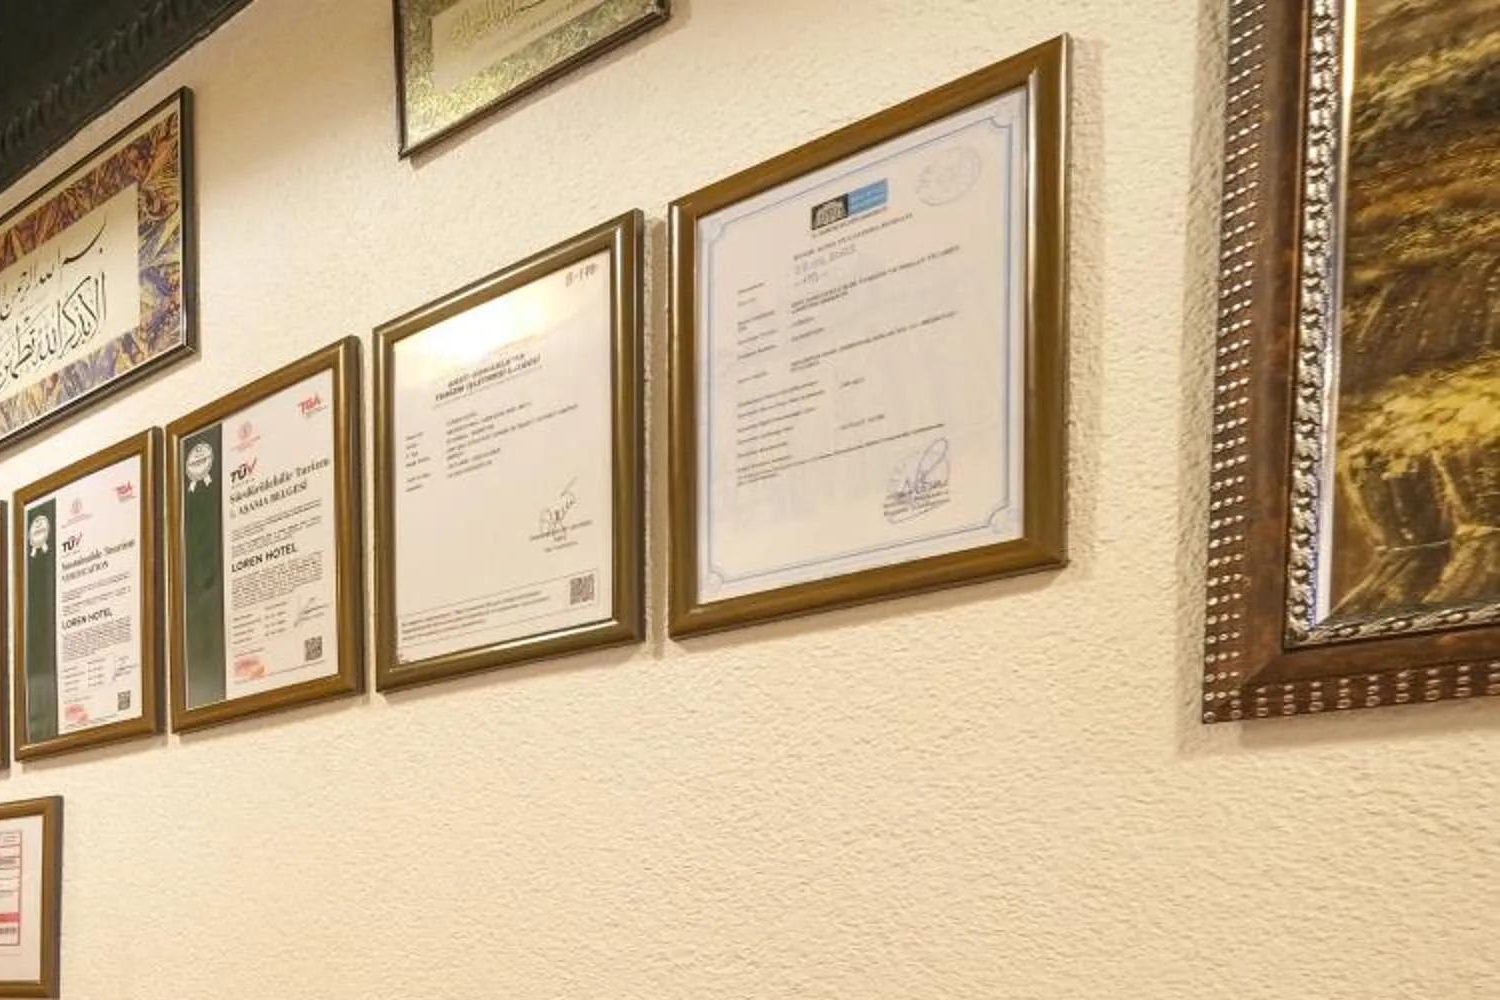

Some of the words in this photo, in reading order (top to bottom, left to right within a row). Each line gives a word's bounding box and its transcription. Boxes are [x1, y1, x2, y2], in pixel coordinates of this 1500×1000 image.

[230, 457, 258, 483] TÜV
[231, 554, 263, 573] LOREN
[265, 542, 297, 562] HOTEL
